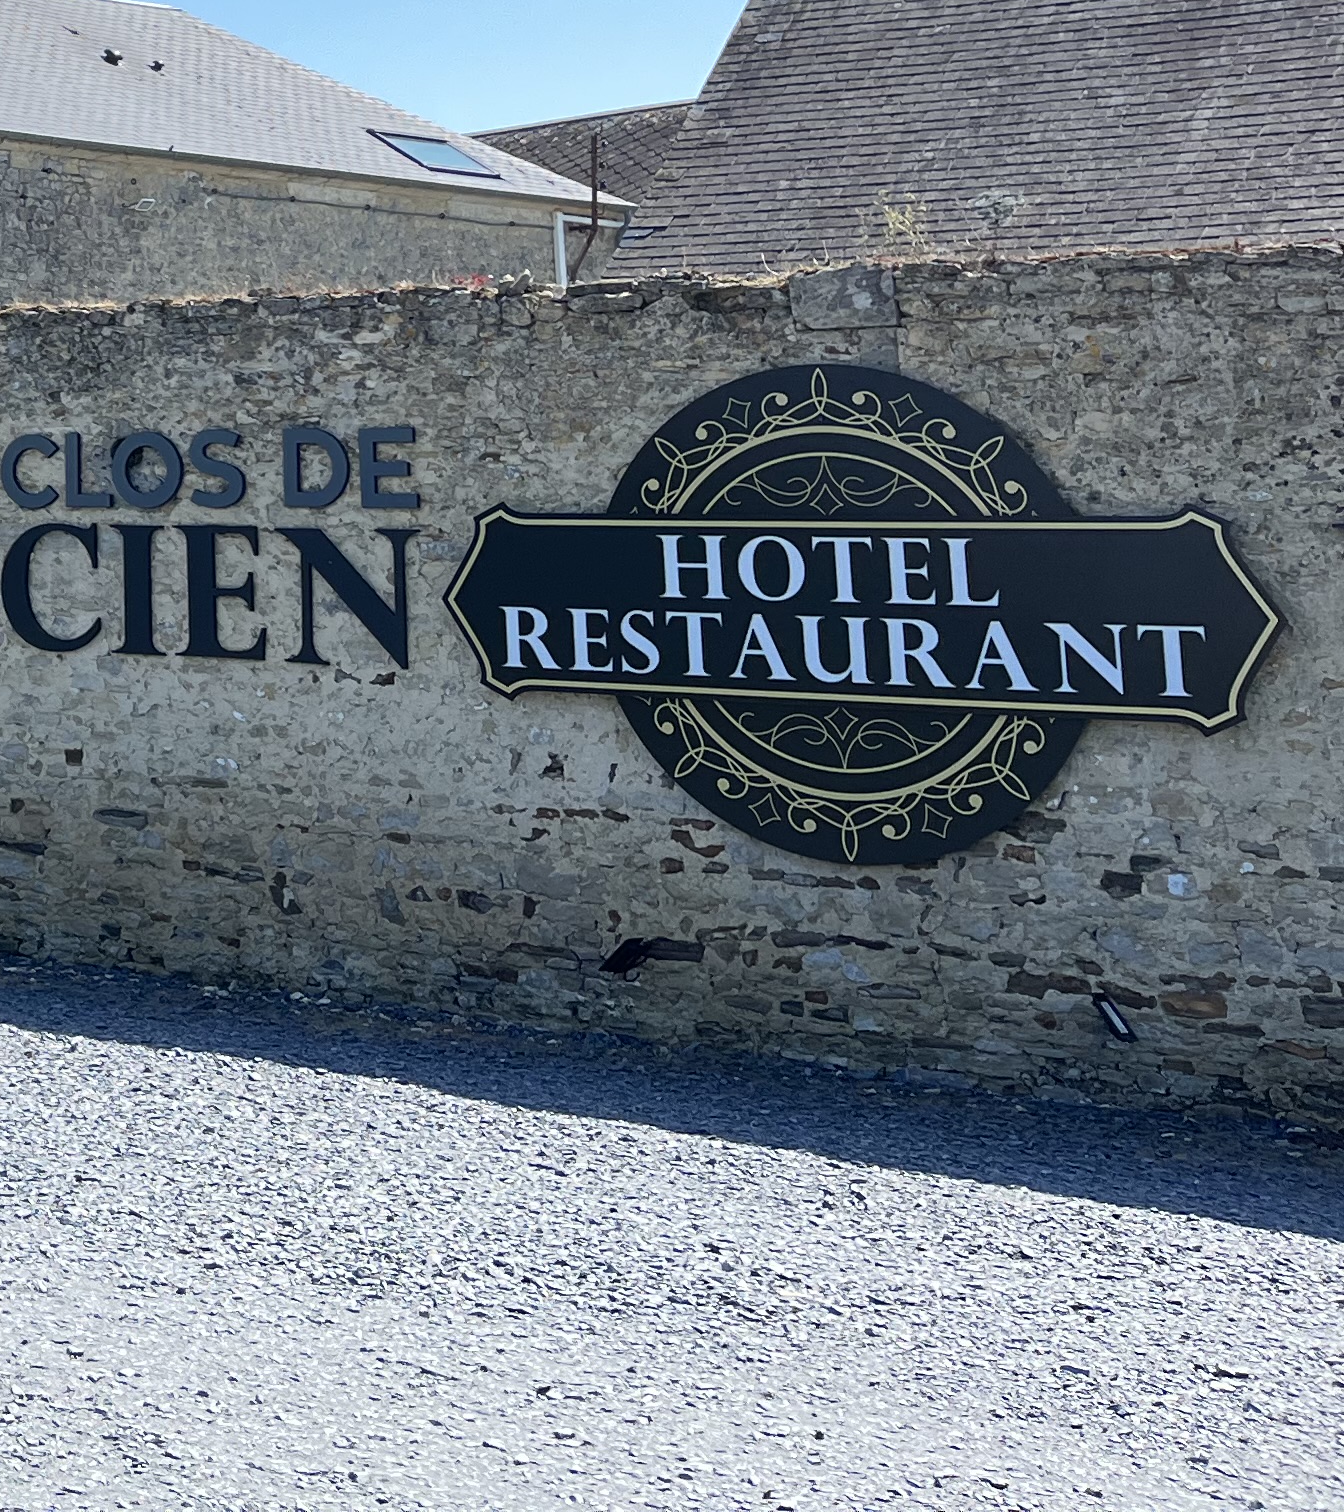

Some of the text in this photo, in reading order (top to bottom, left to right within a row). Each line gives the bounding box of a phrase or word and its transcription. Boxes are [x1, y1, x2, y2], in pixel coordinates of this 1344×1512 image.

[0, 429, 247, 509] CLOS
[282, 426, 421, 509] DE
[655, 534, 1000, 608] HOTEL
[498, 605, 1207, 698] RESTAURANT
